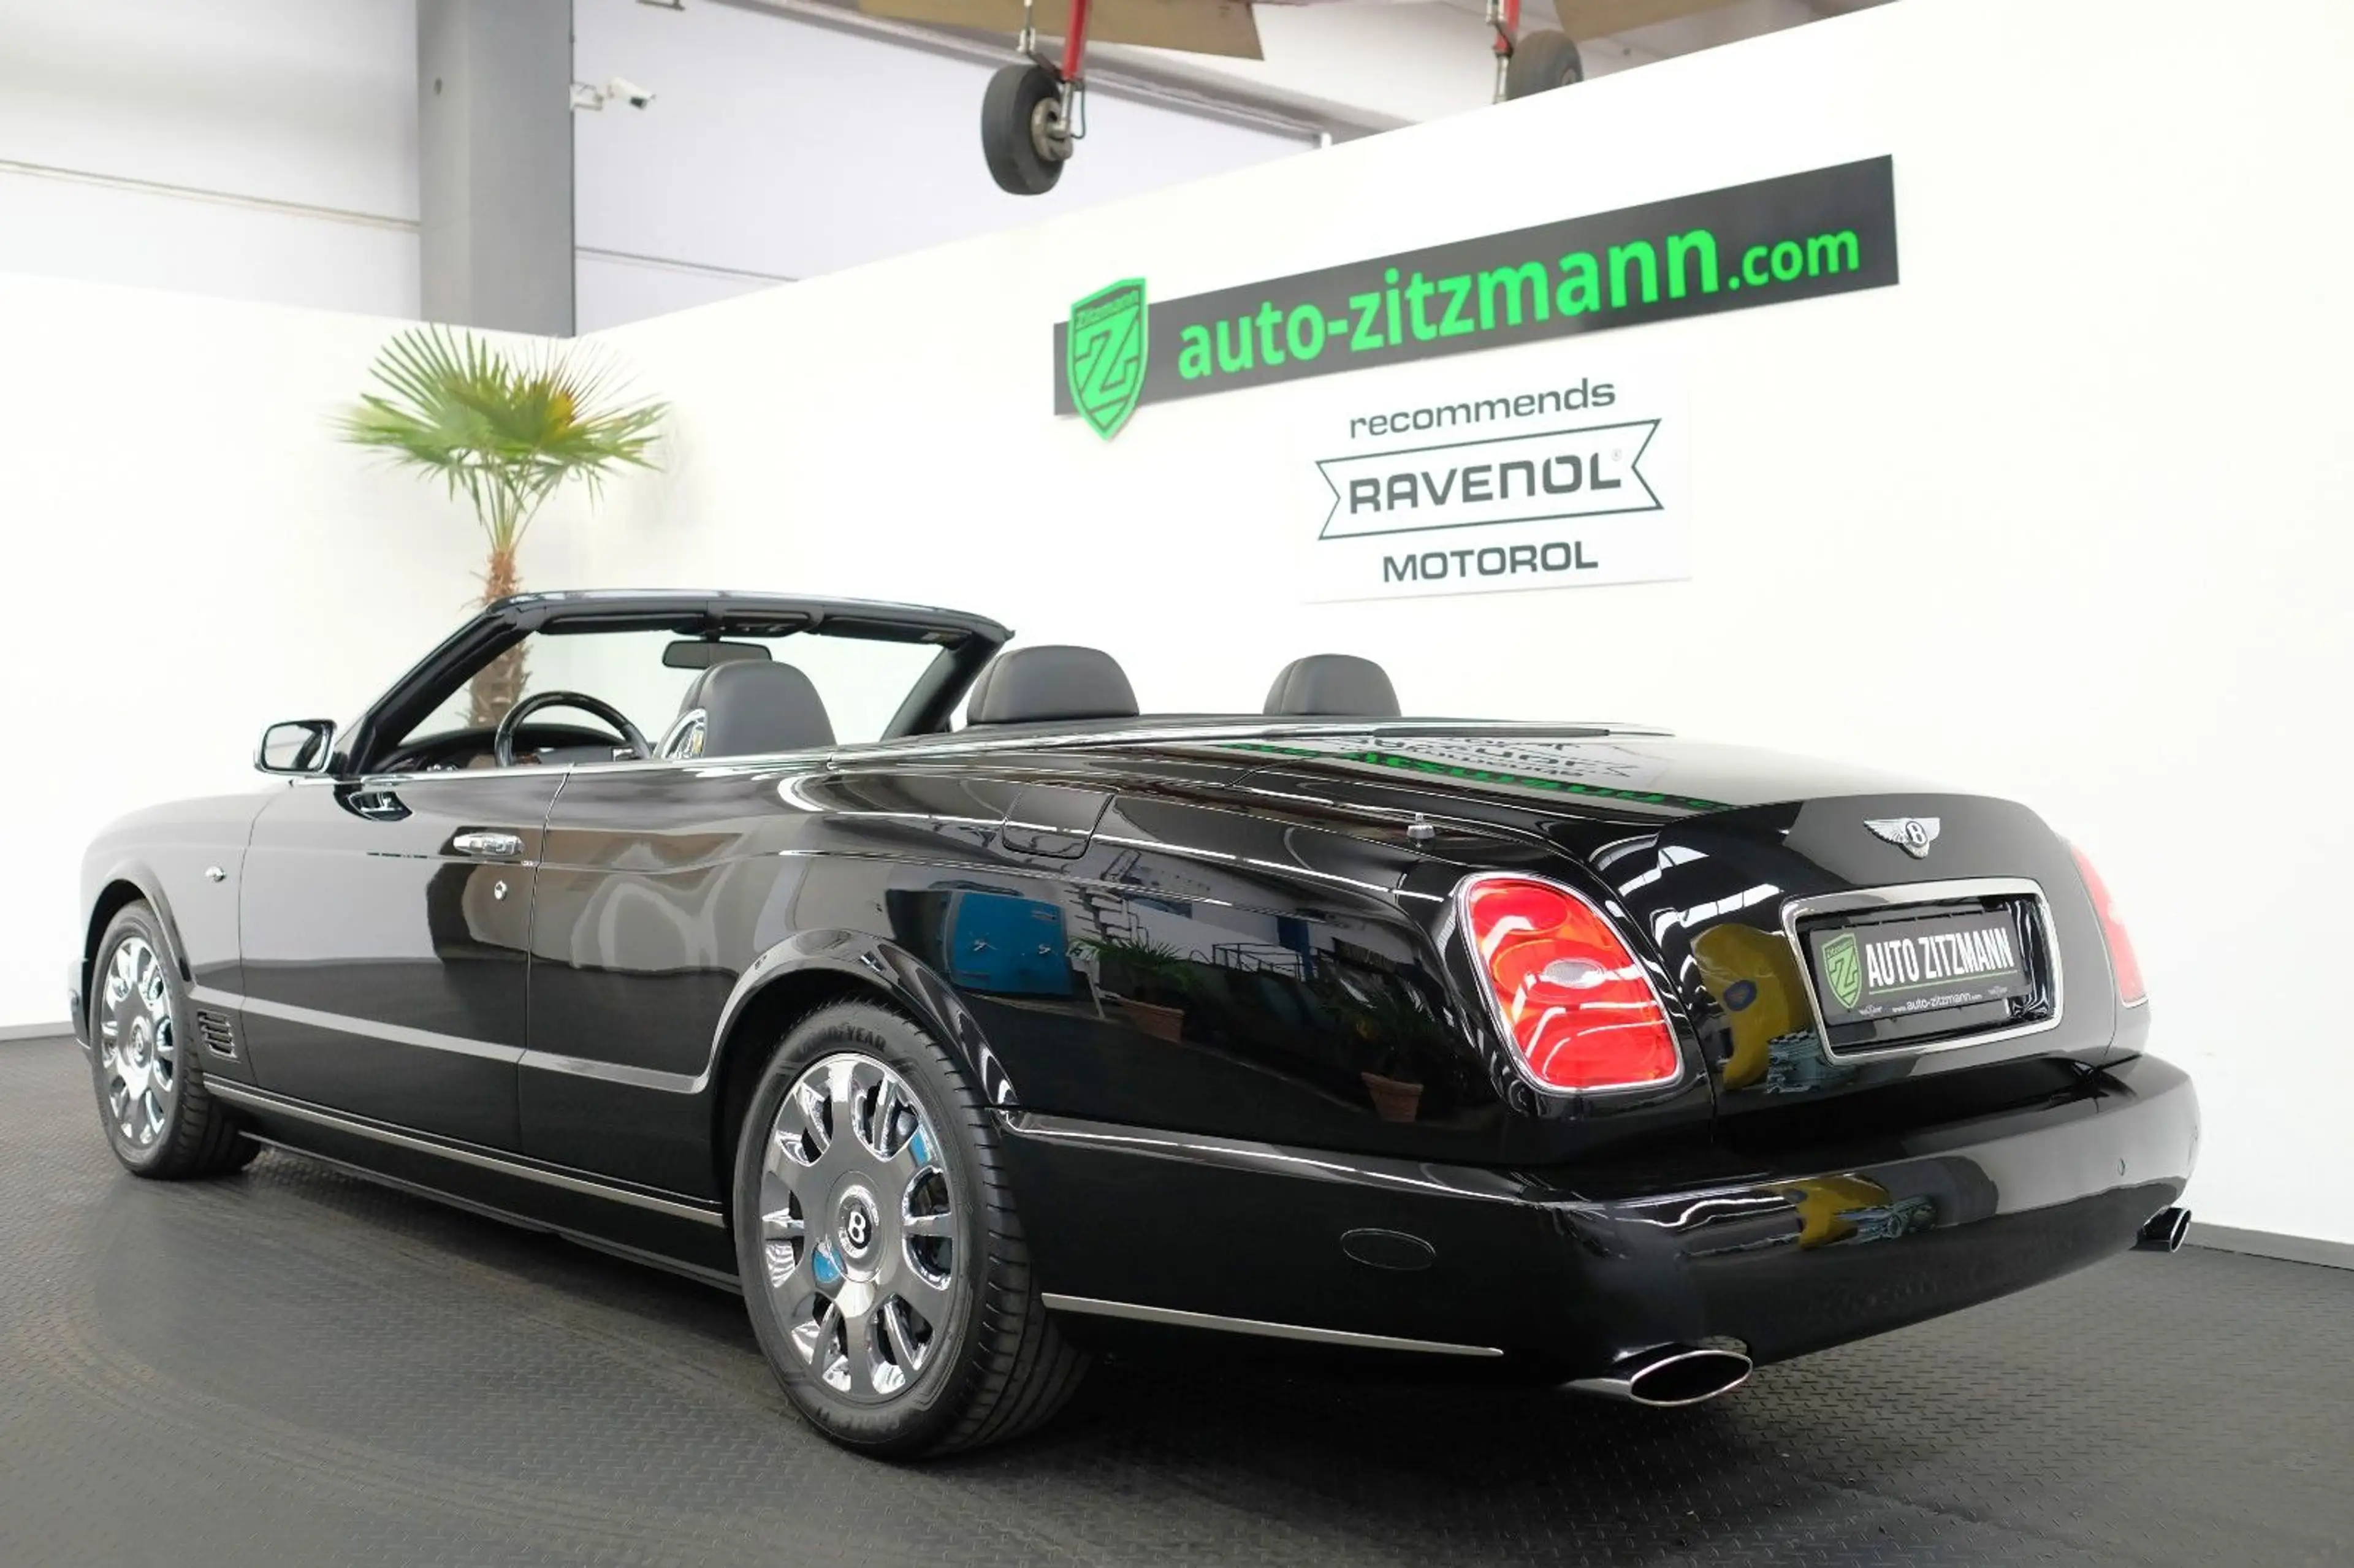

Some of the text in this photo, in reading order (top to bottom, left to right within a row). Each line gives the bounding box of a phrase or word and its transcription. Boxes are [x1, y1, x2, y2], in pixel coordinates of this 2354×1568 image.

[1178, 229, 1859, 380] auto-zitzmann.com
[1350, 378, 1616, 438] recommends
[1350, 452, 1621, 514] RAVENOL
[1384, 541, 1599, 582] MOTOROL
[1865, 927, 2016, 988] AUTO ZITZMANN
[847, 1211, 866, 1243] B
